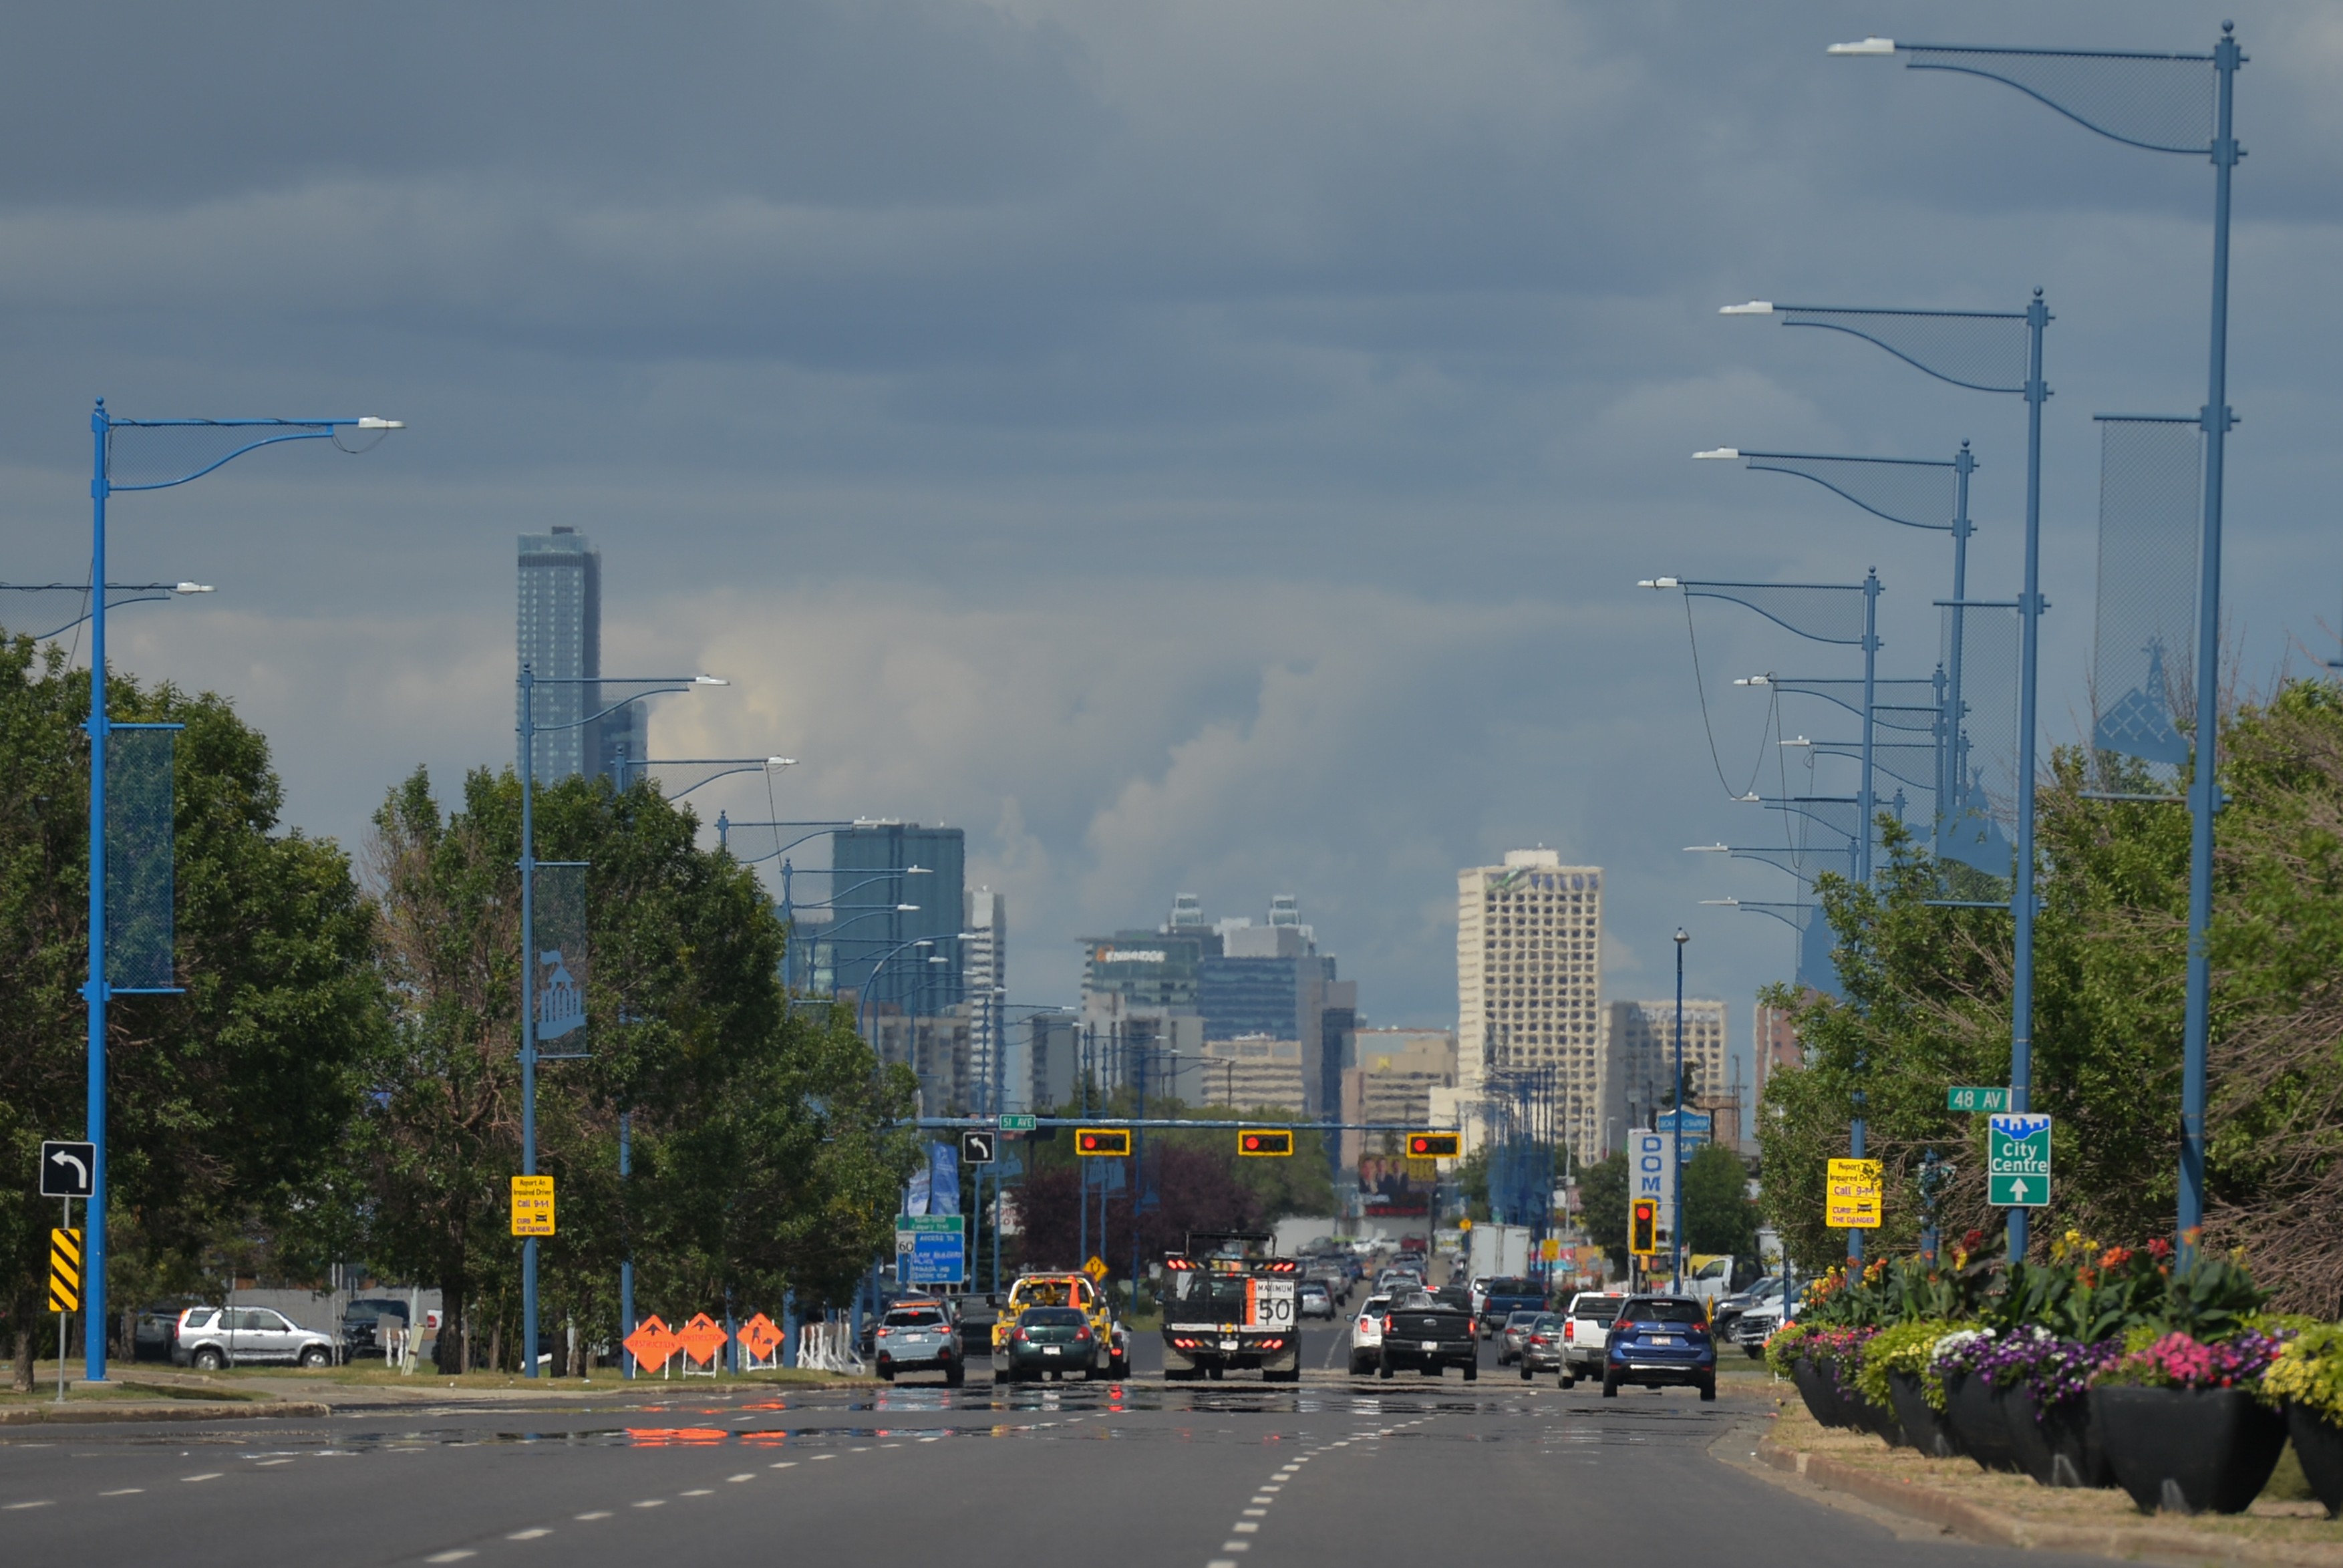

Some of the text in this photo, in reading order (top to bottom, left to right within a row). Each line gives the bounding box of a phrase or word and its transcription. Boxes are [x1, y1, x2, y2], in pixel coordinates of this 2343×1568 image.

[1954, 1090, 2002, 1108] 48 AV
[1003, 1117, 1032, 1127] 51 AVE
[2002, 1141, 2038, 1160] City
[1838, 1162, 1861, 1172] Report
[1992, 1157, 2048, 1172] Centre
[1830, 1173, 1857, 1183] Impaired
[519, 1179, 537, 1187] Report
[513, 1189, 535, 1197] Impaired
[1834, 1186, 1851, 1195] Call
[517, 1199, 549, 1208] Call 9-1-1
[1847, 1216, 1875, 1224] DANGER
[899, 1241, 914, 1252] 60
[1257, 1284, 1292, 1293] MAXIMUM
[1259, 1298, 1290, 1321] 50
[679, 1334, 723, 1342] CONSTRUCTION
[629, 1340, 675, 1349] OBSTRUCTION
